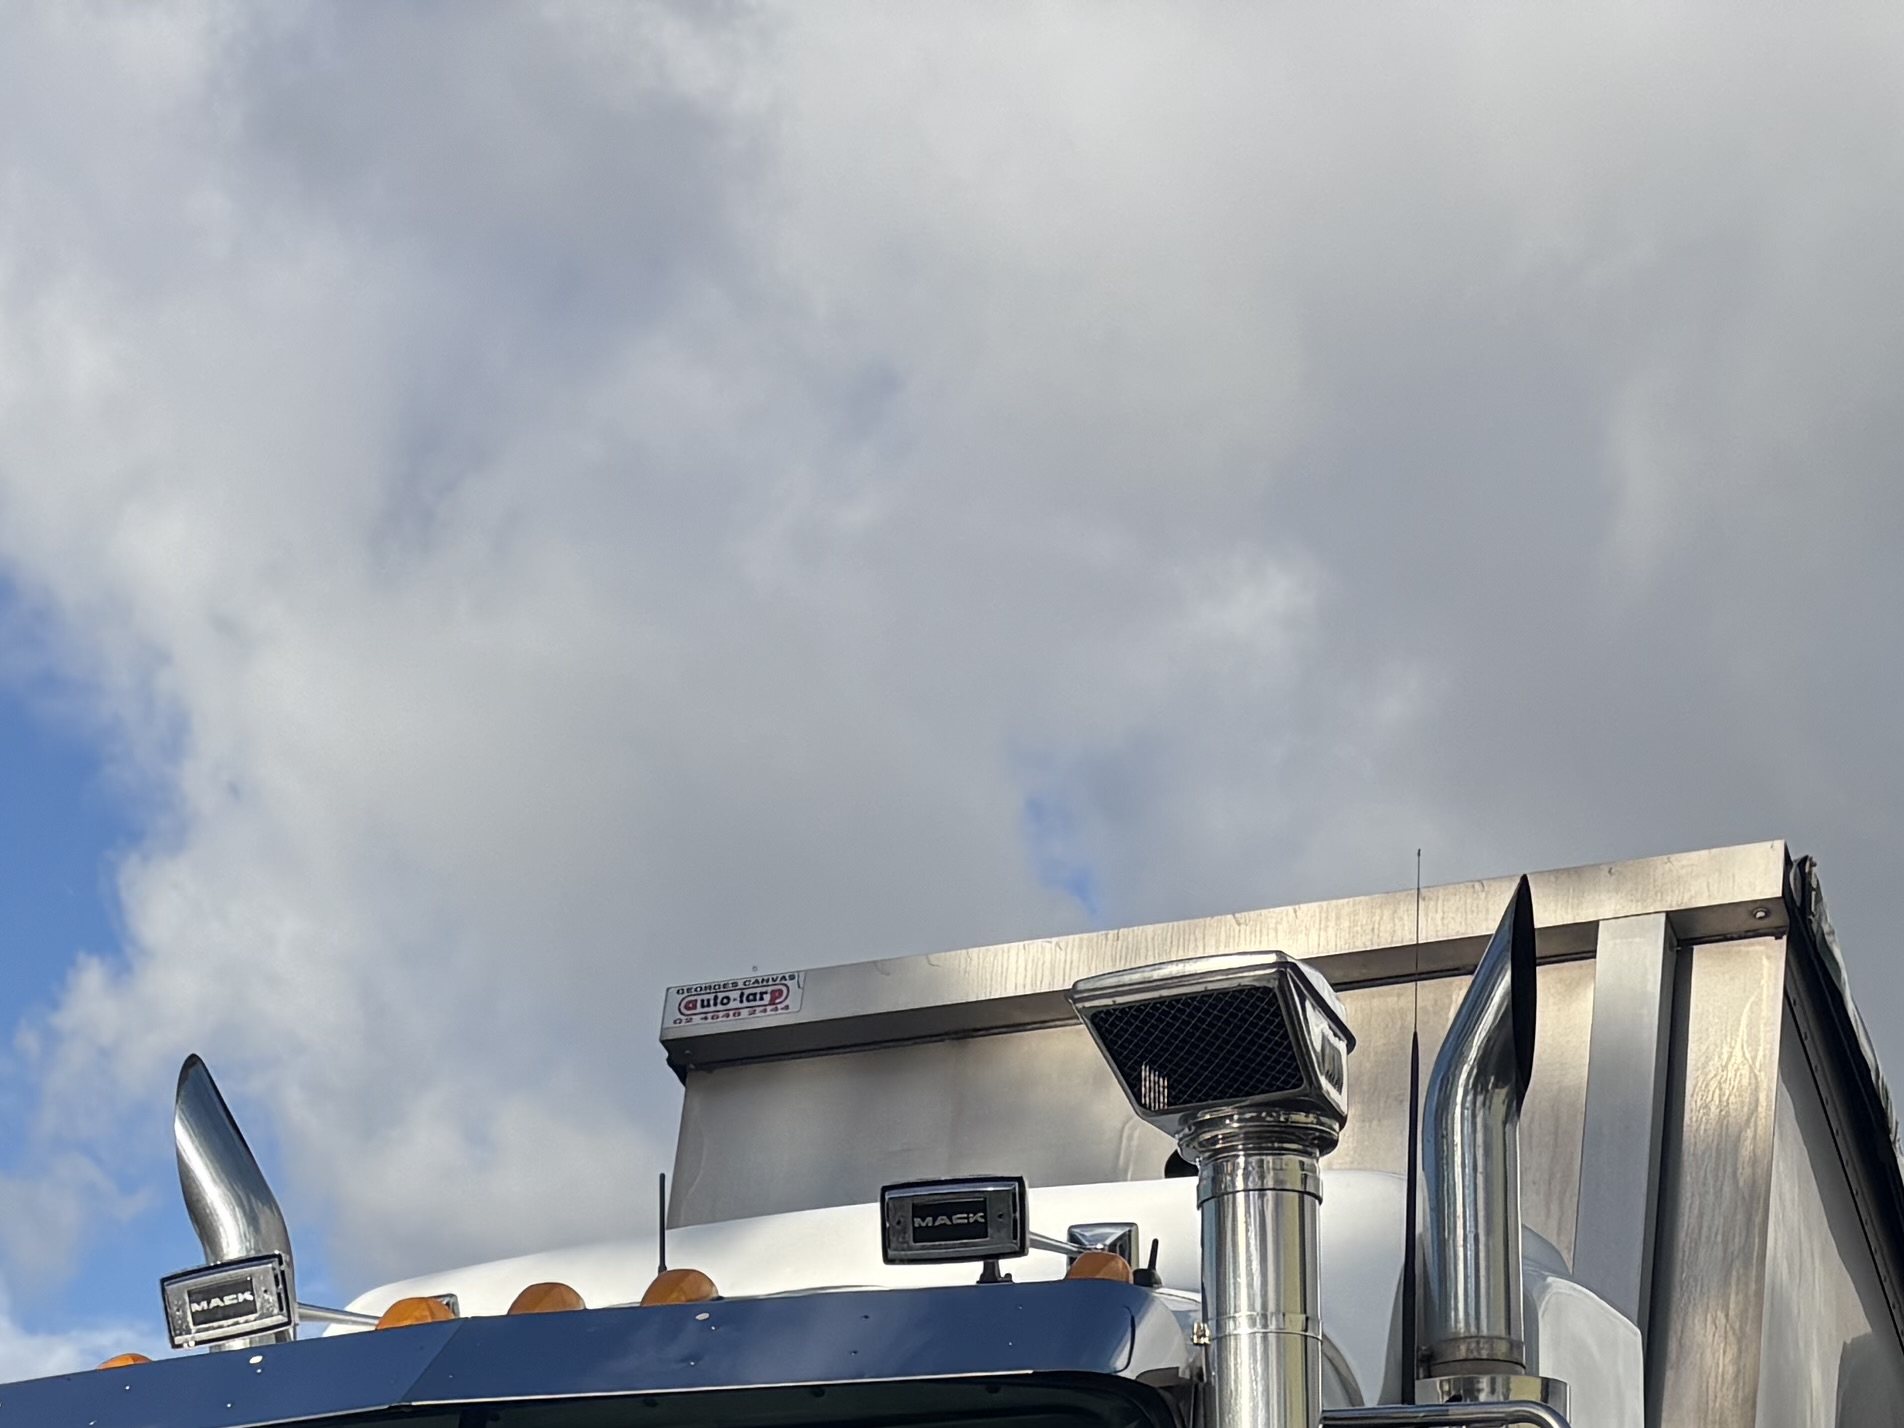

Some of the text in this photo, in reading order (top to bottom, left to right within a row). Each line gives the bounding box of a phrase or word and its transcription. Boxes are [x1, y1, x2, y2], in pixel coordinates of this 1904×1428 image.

[743, 974, 796, 987] CANVAS
[913, 1212, 985, 1228] MACK
[190, 1290, 254, 1313] MACK
